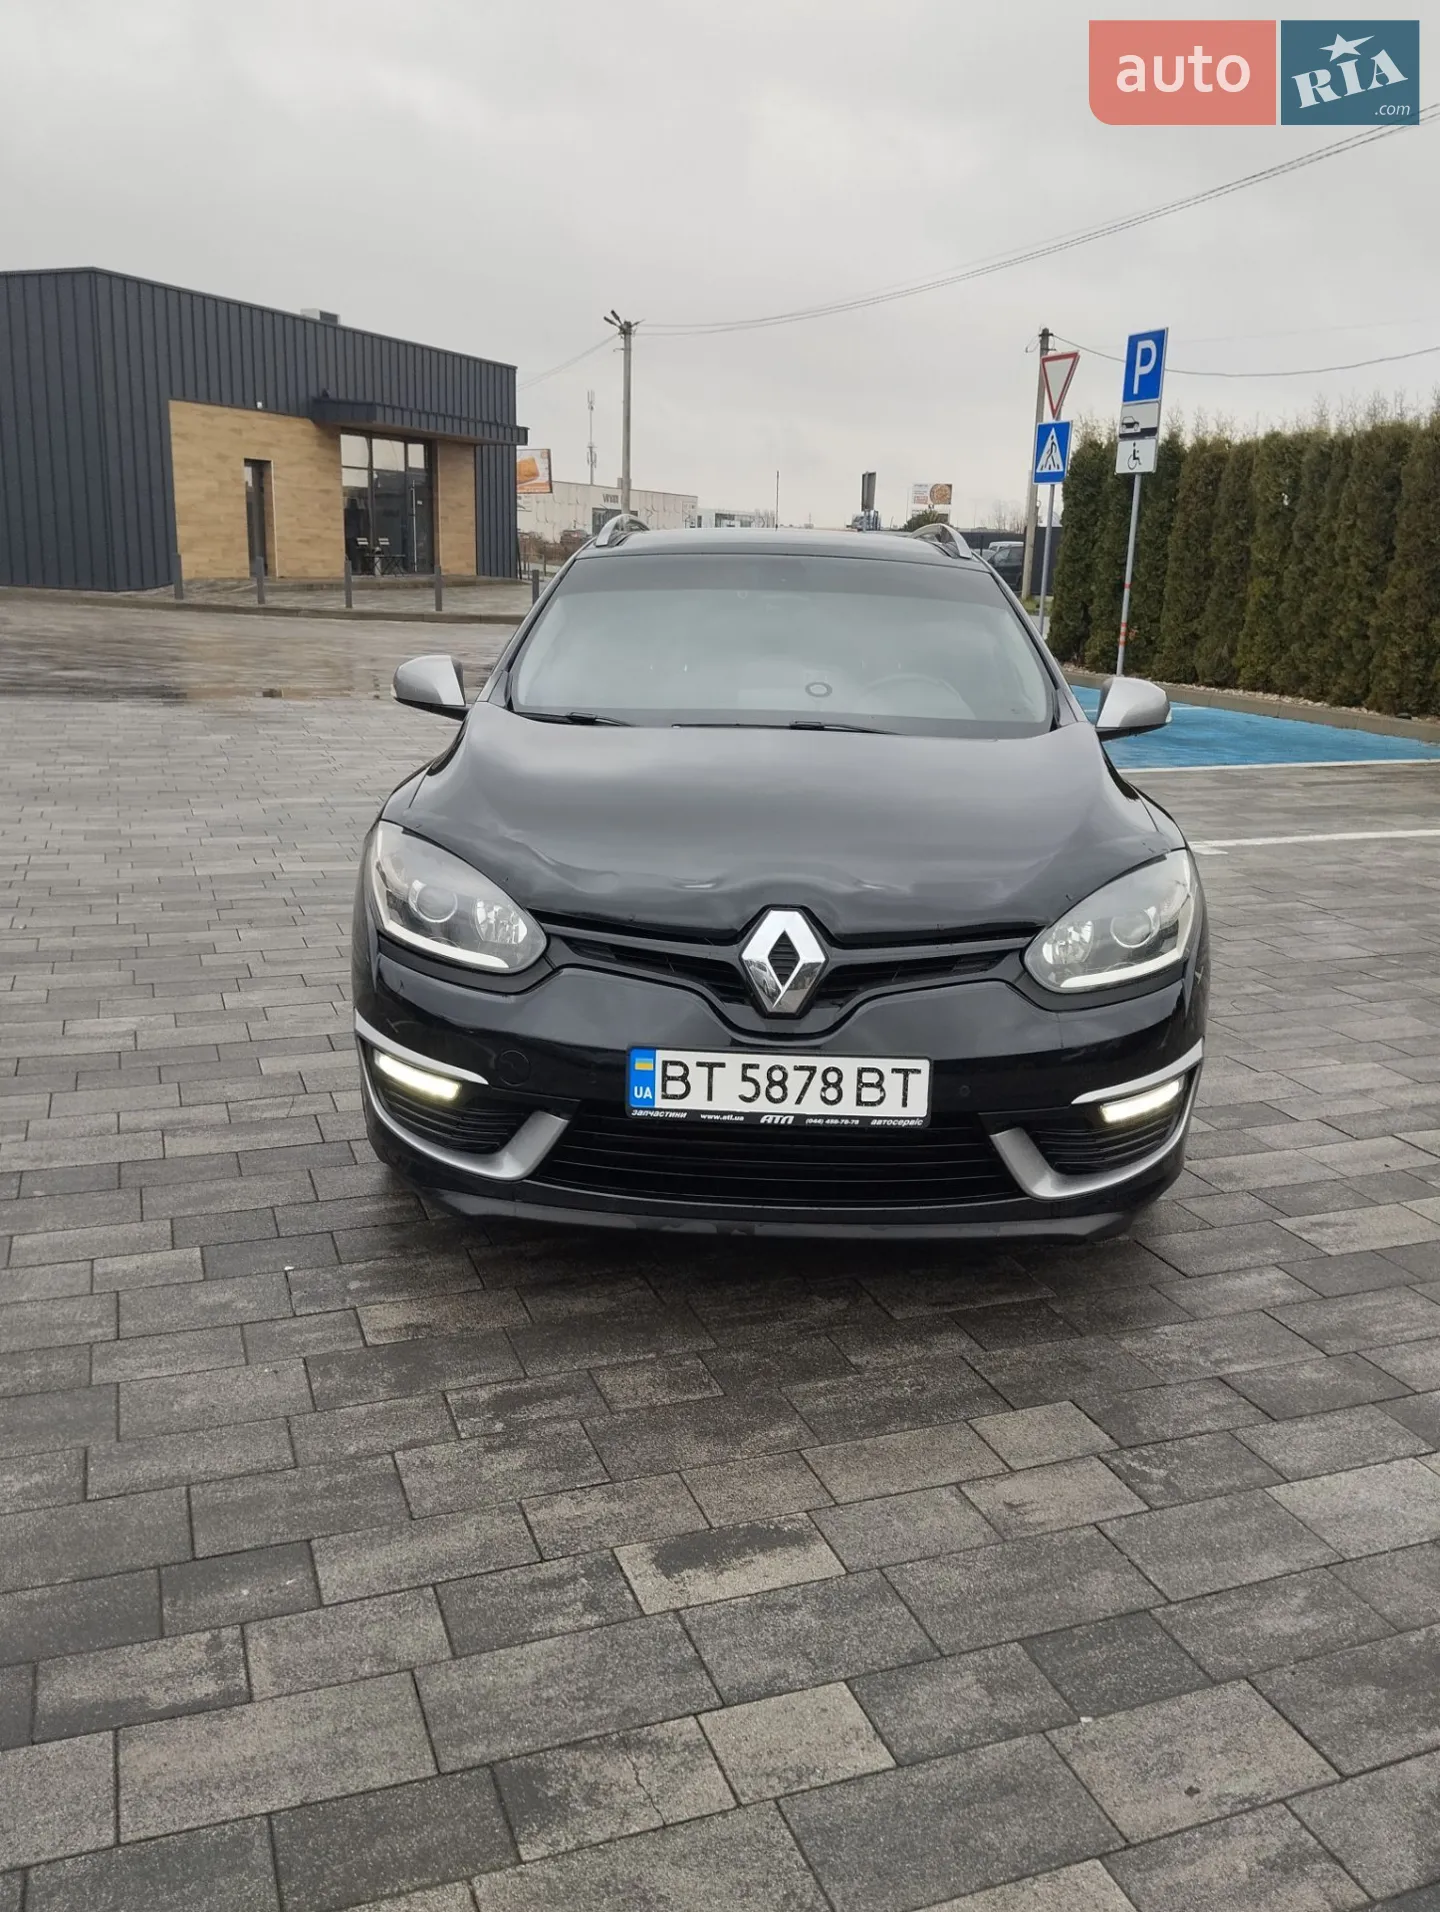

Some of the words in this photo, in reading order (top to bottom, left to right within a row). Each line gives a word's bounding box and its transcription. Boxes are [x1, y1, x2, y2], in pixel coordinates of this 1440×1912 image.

[1132, 338, 1157, 395] P
[633, 1086, 653, 1100] UA
[660, 1059, 726, 1101] BT
[737, 1062, 844, 1106] 5878
[855, 1066, 922, 1108] BT
